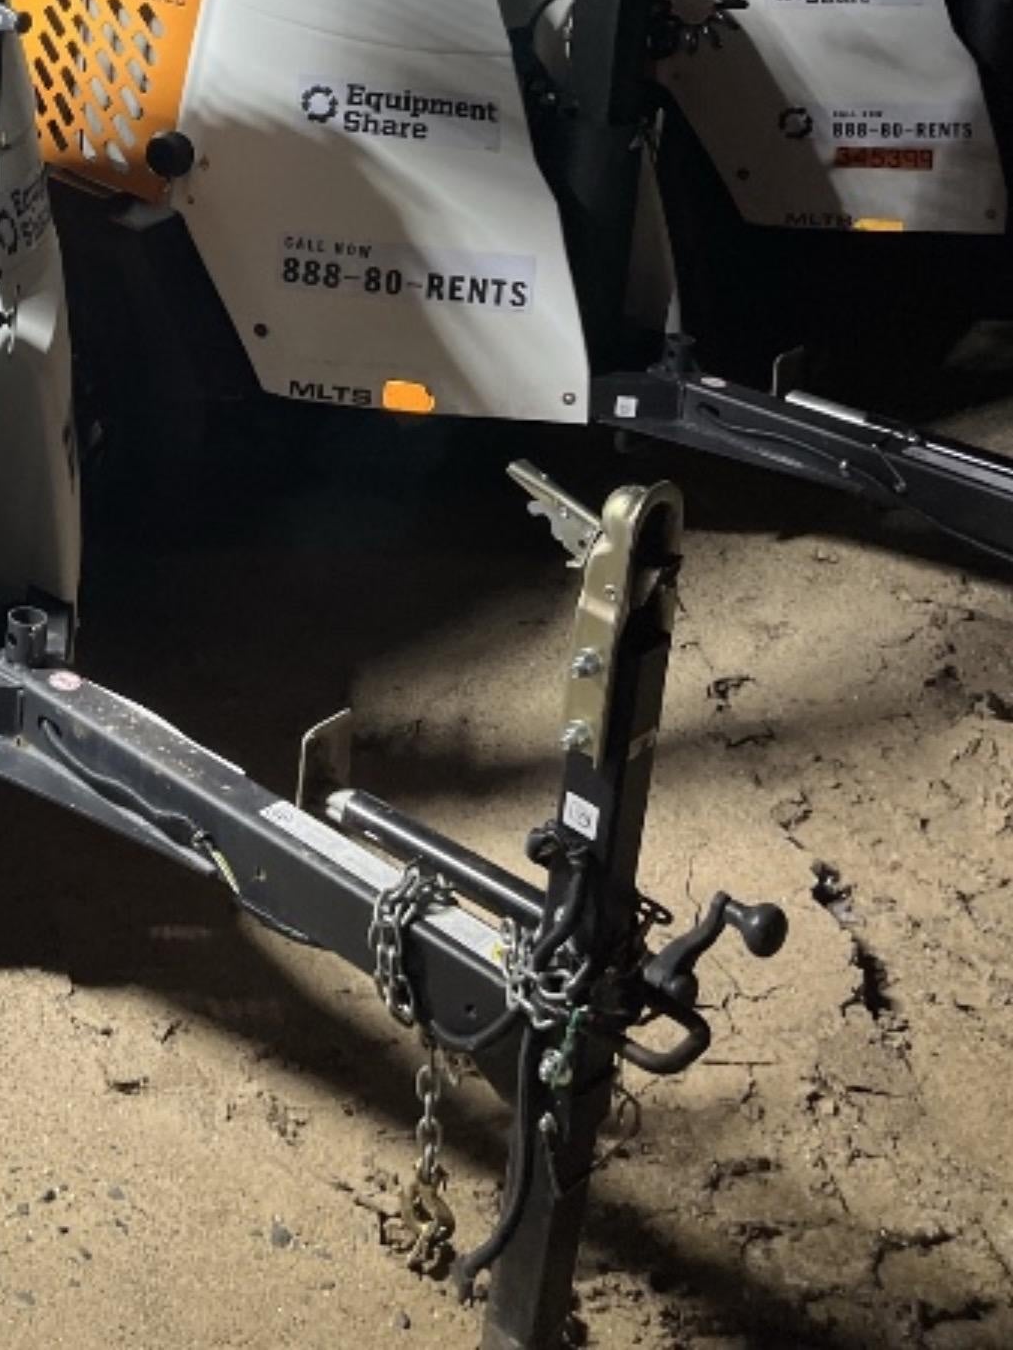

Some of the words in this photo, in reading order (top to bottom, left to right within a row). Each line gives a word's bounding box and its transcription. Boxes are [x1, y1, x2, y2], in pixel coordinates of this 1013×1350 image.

[346, 83, 499, 123] Equipment
[343, 110, 428, 140] Share
[831, 122, 973, 140] 888-80-RENTS
[282, 256, 529, 308] 888-80-RENTS
[288, 380, 373, 406] MLTS
